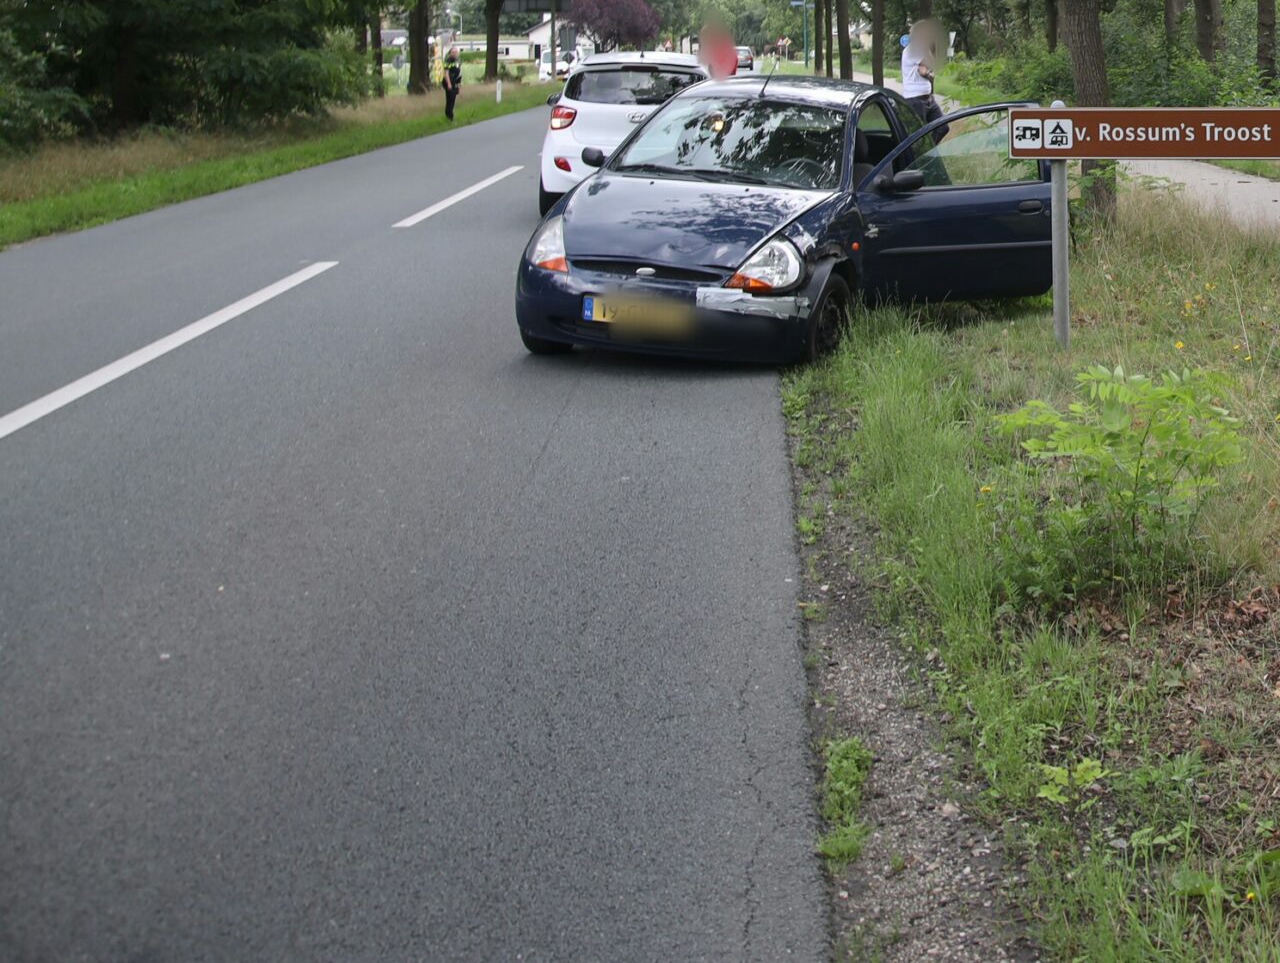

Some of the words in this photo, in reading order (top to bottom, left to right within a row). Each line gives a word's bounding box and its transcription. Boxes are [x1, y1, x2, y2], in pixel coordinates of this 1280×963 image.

[1074, 126, 1091, 142] v.
[1098, 123, 1196, 142] Rossum's
[1201, 122, 1272, 142] Troost
